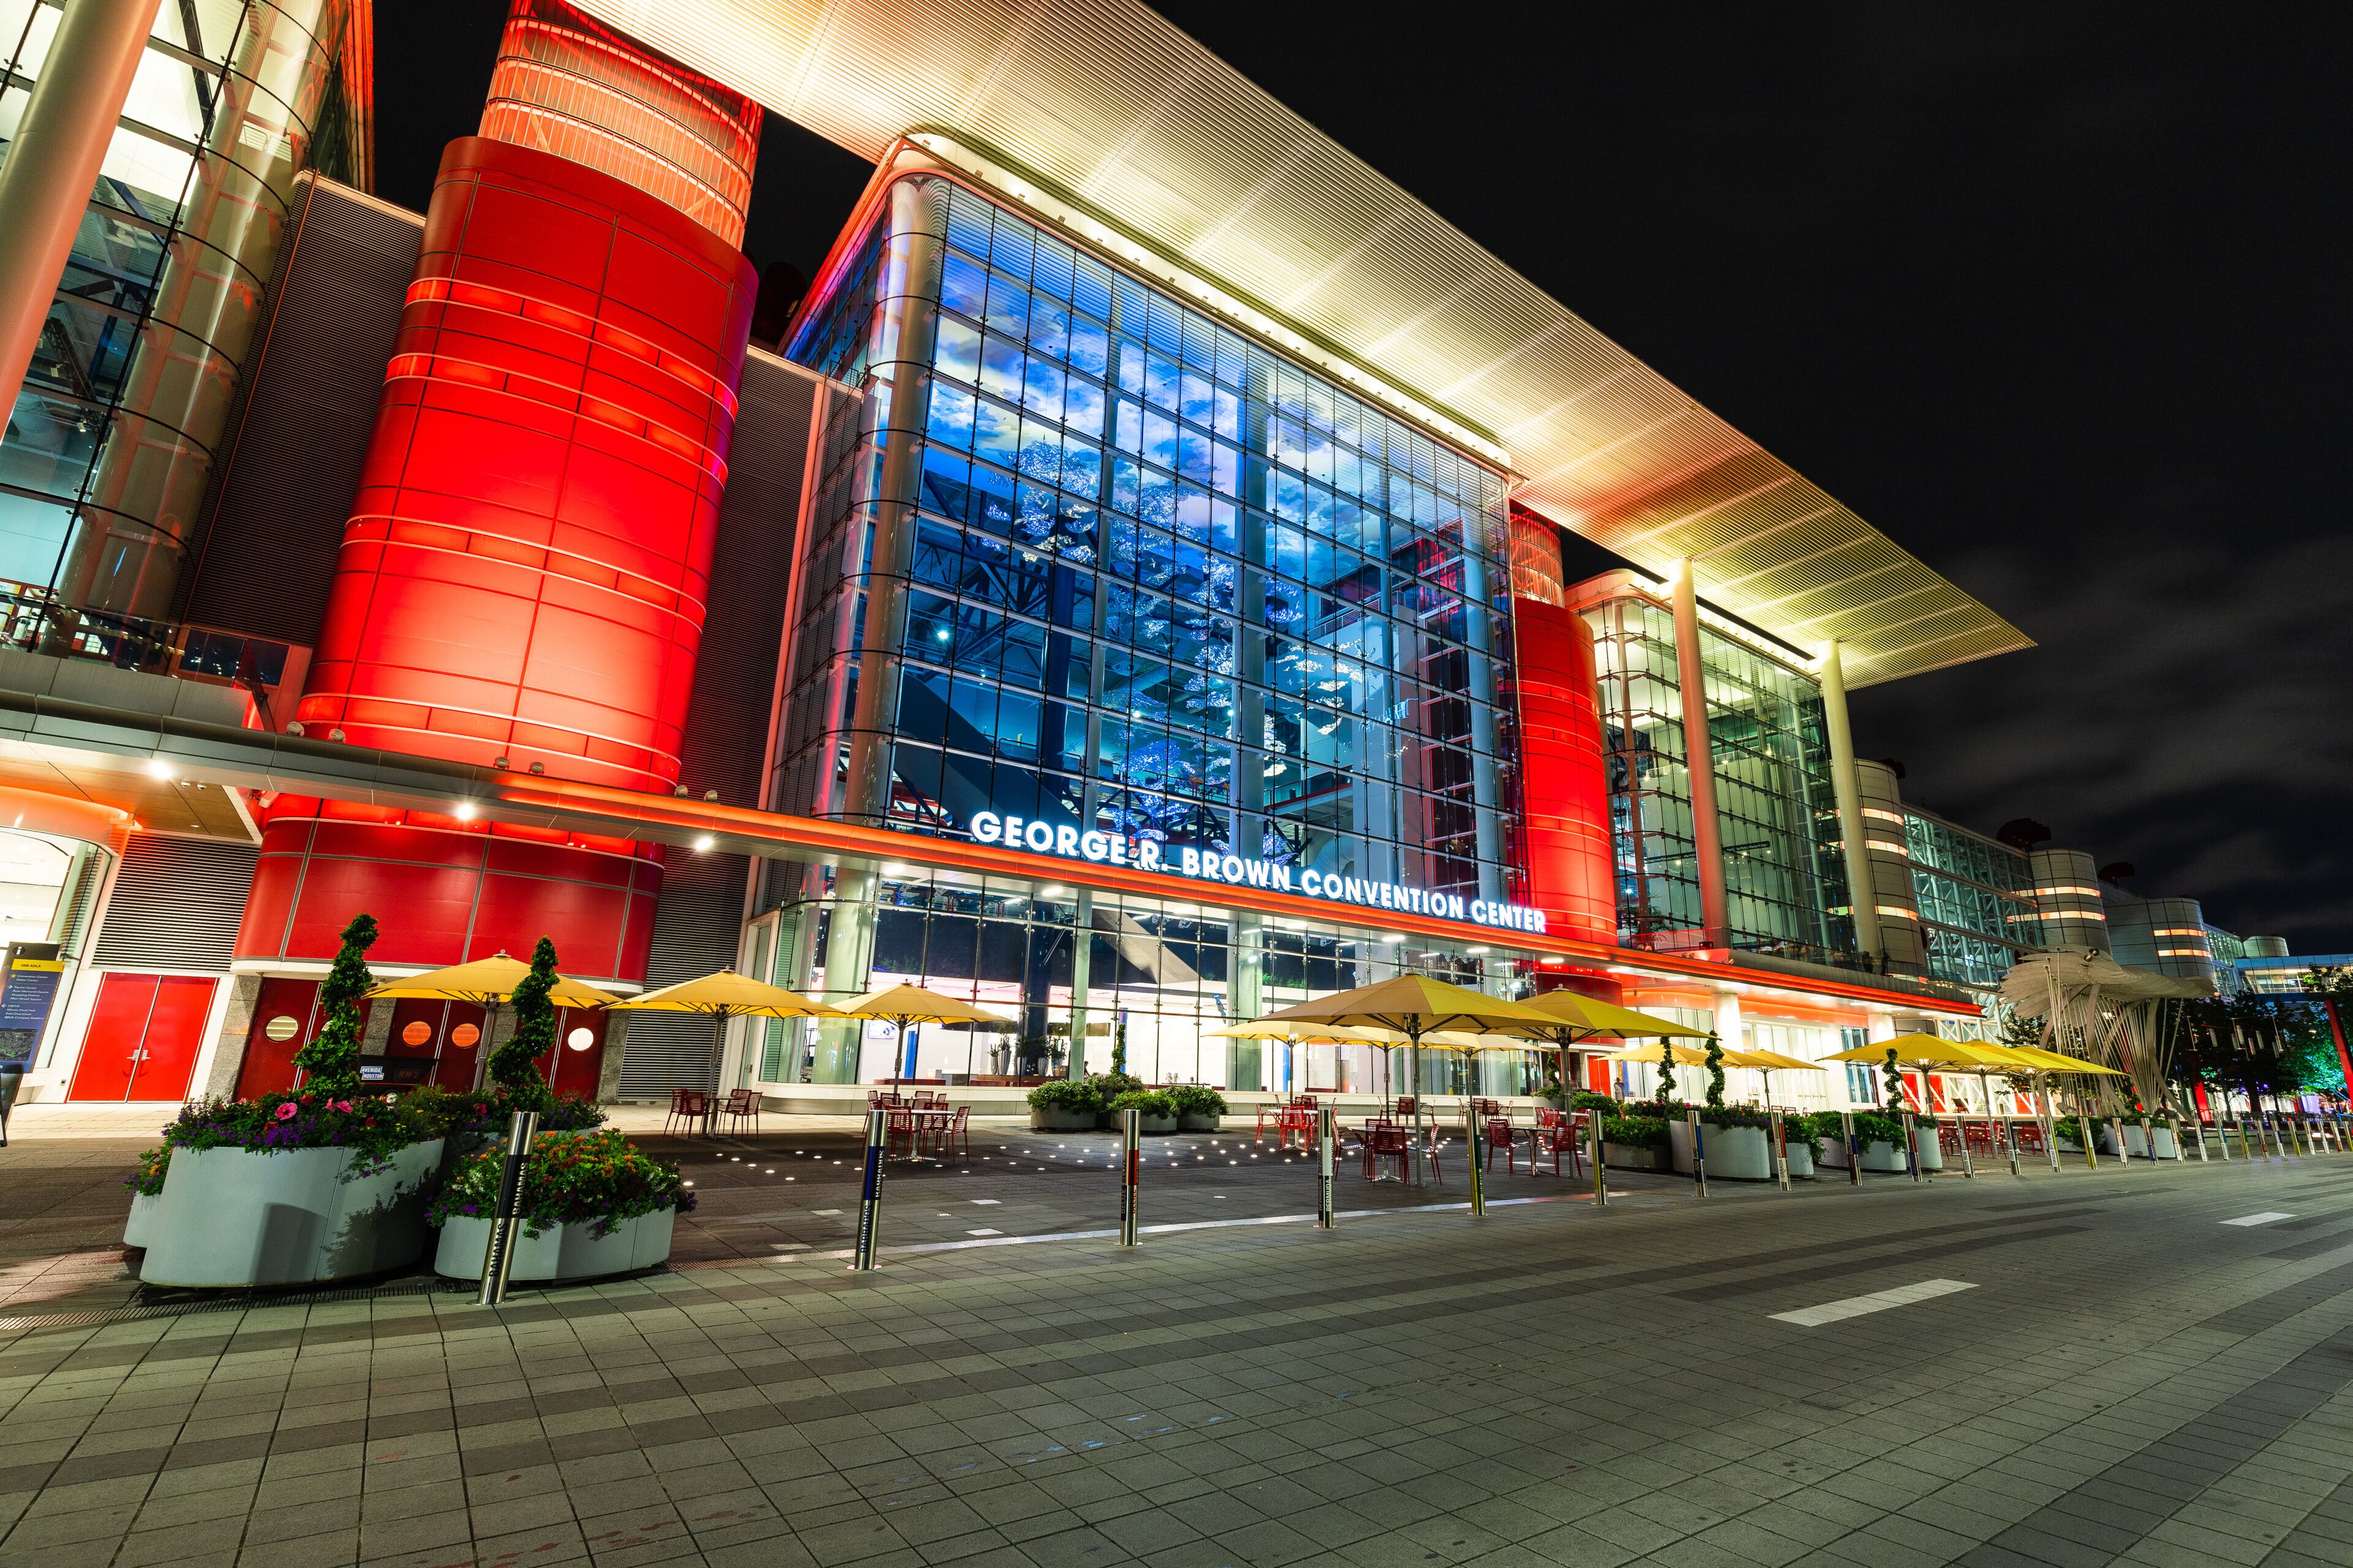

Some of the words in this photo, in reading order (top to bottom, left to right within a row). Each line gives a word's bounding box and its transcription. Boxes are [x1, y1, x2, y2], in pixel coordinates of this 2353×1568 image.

[971, 811, 1126, 865] GEORGE
[1139, 839, 1168, 871] R.
[1182, 847, 1290, 890] BROWN
[1301, 869, 1463, 920] CONVENTION
[1471, 900, 1547, 933] CENTER
[512, 1162, 529, 1216] BAHAMAS
[488, 1222, 508, 1278] BAHAMAS
[860, 1204, 872, 1254] BARBADOS
